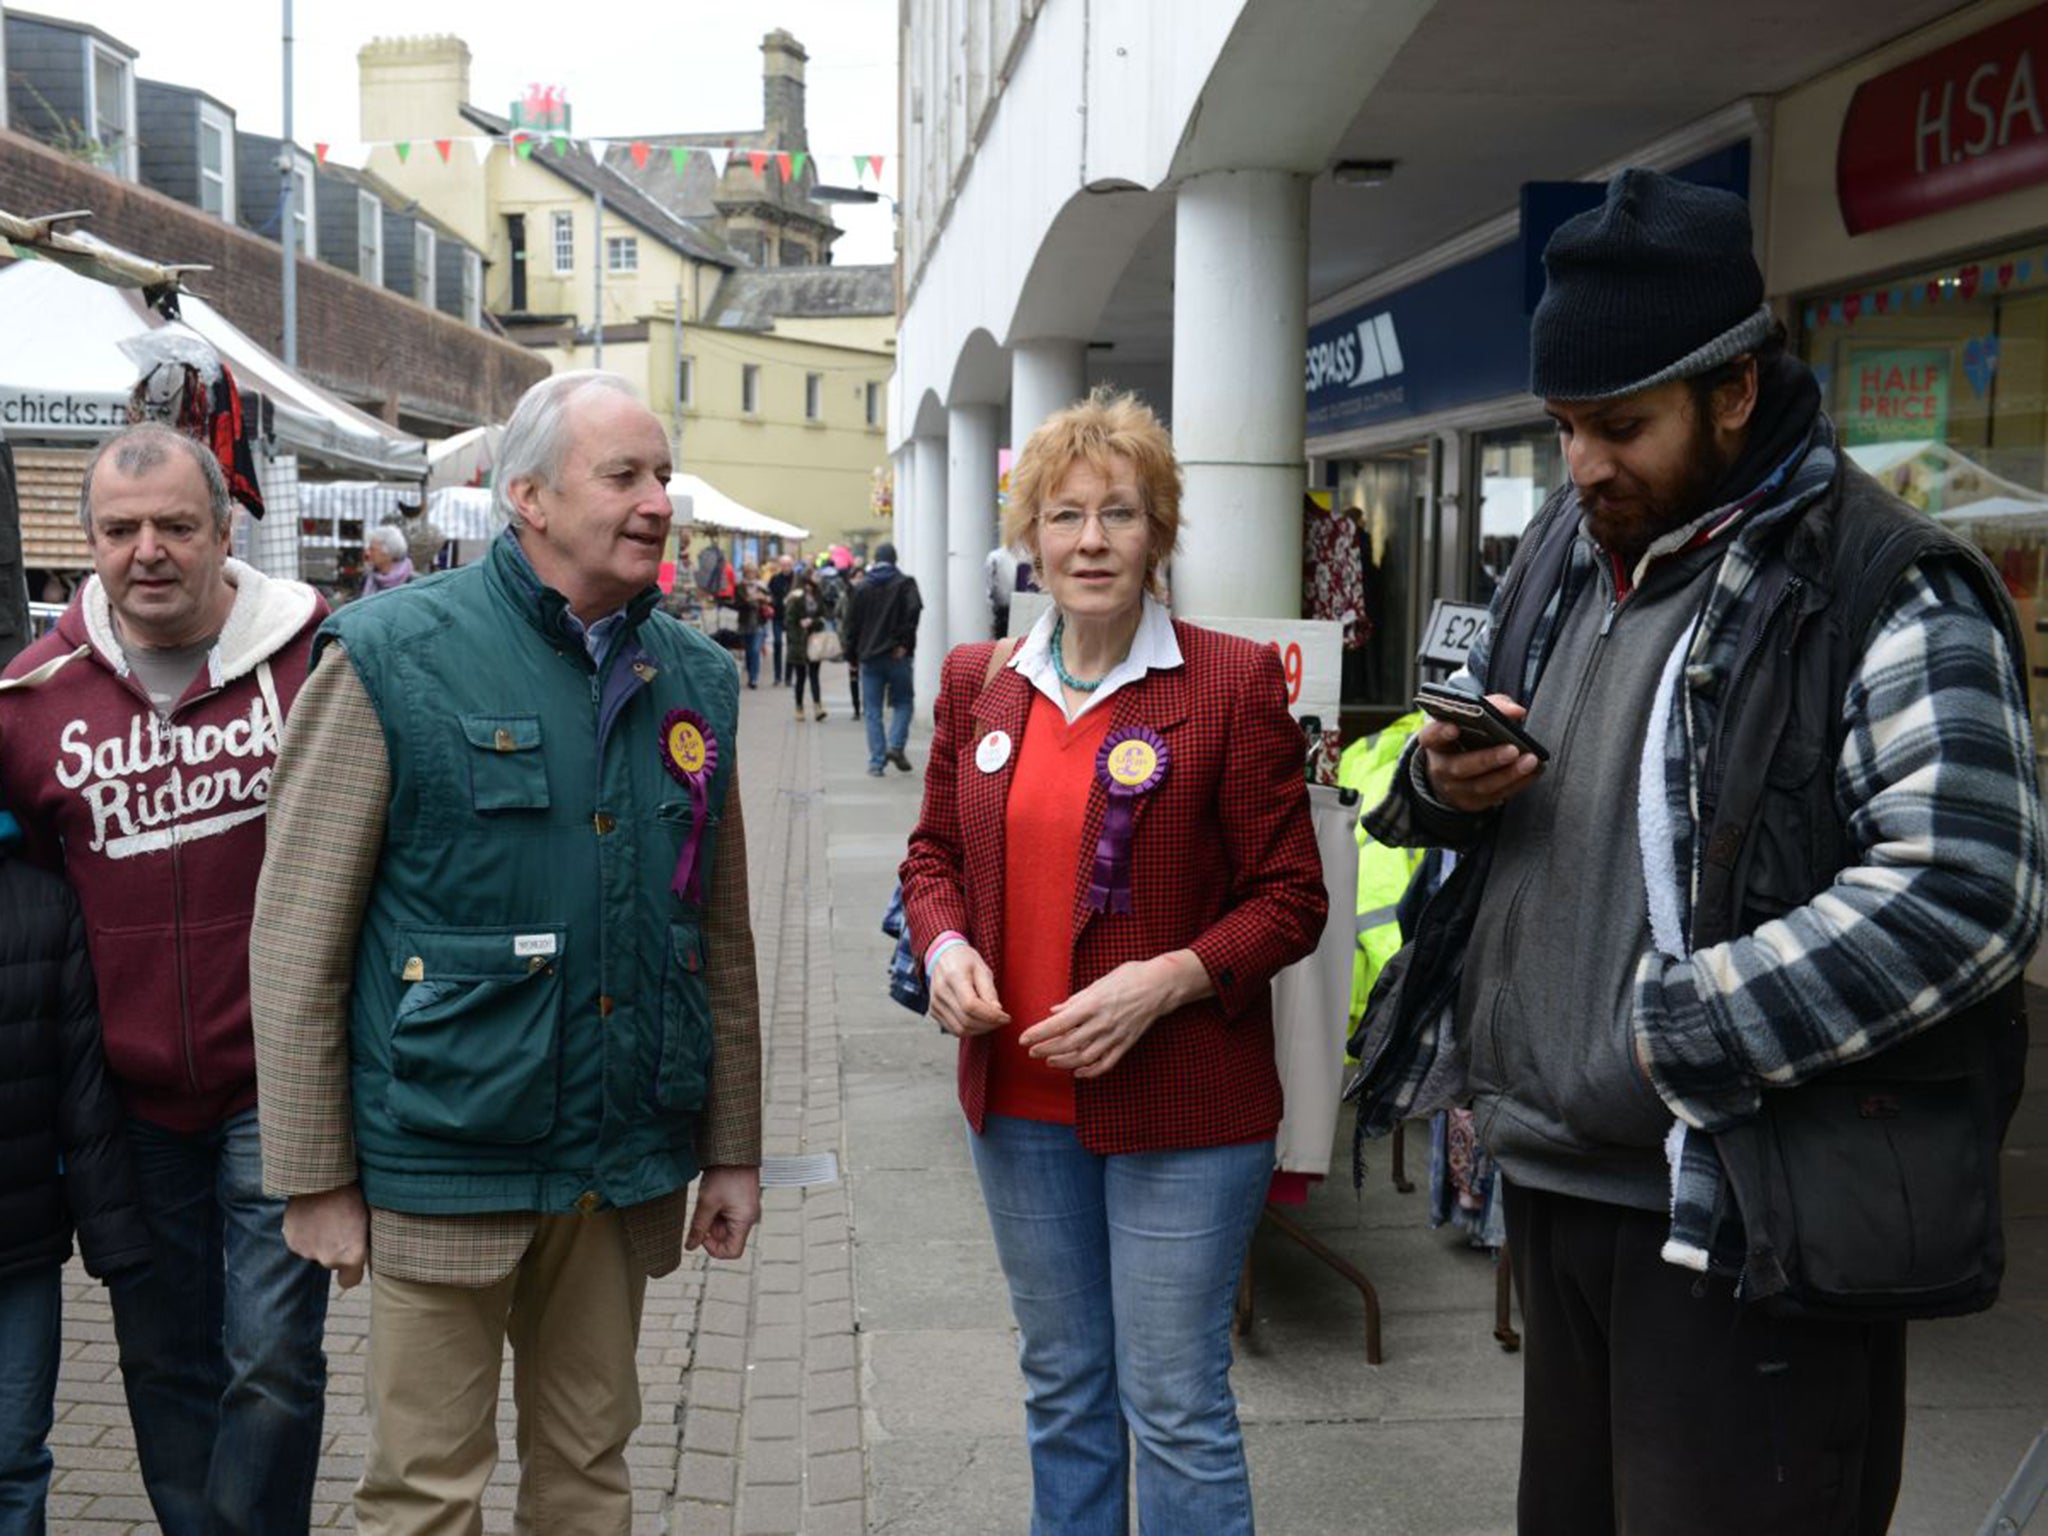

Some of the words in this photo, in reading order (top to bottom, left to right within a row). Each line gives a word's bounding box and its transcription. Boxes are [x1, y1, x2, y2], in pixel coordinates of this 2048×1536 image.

[1861, 364, 1938, 392] HALF
[0, 394, 127, 425] chicks.n
[1860, 395, 1936, 418] PRICE
[81, 766, 272, 852] Riders
